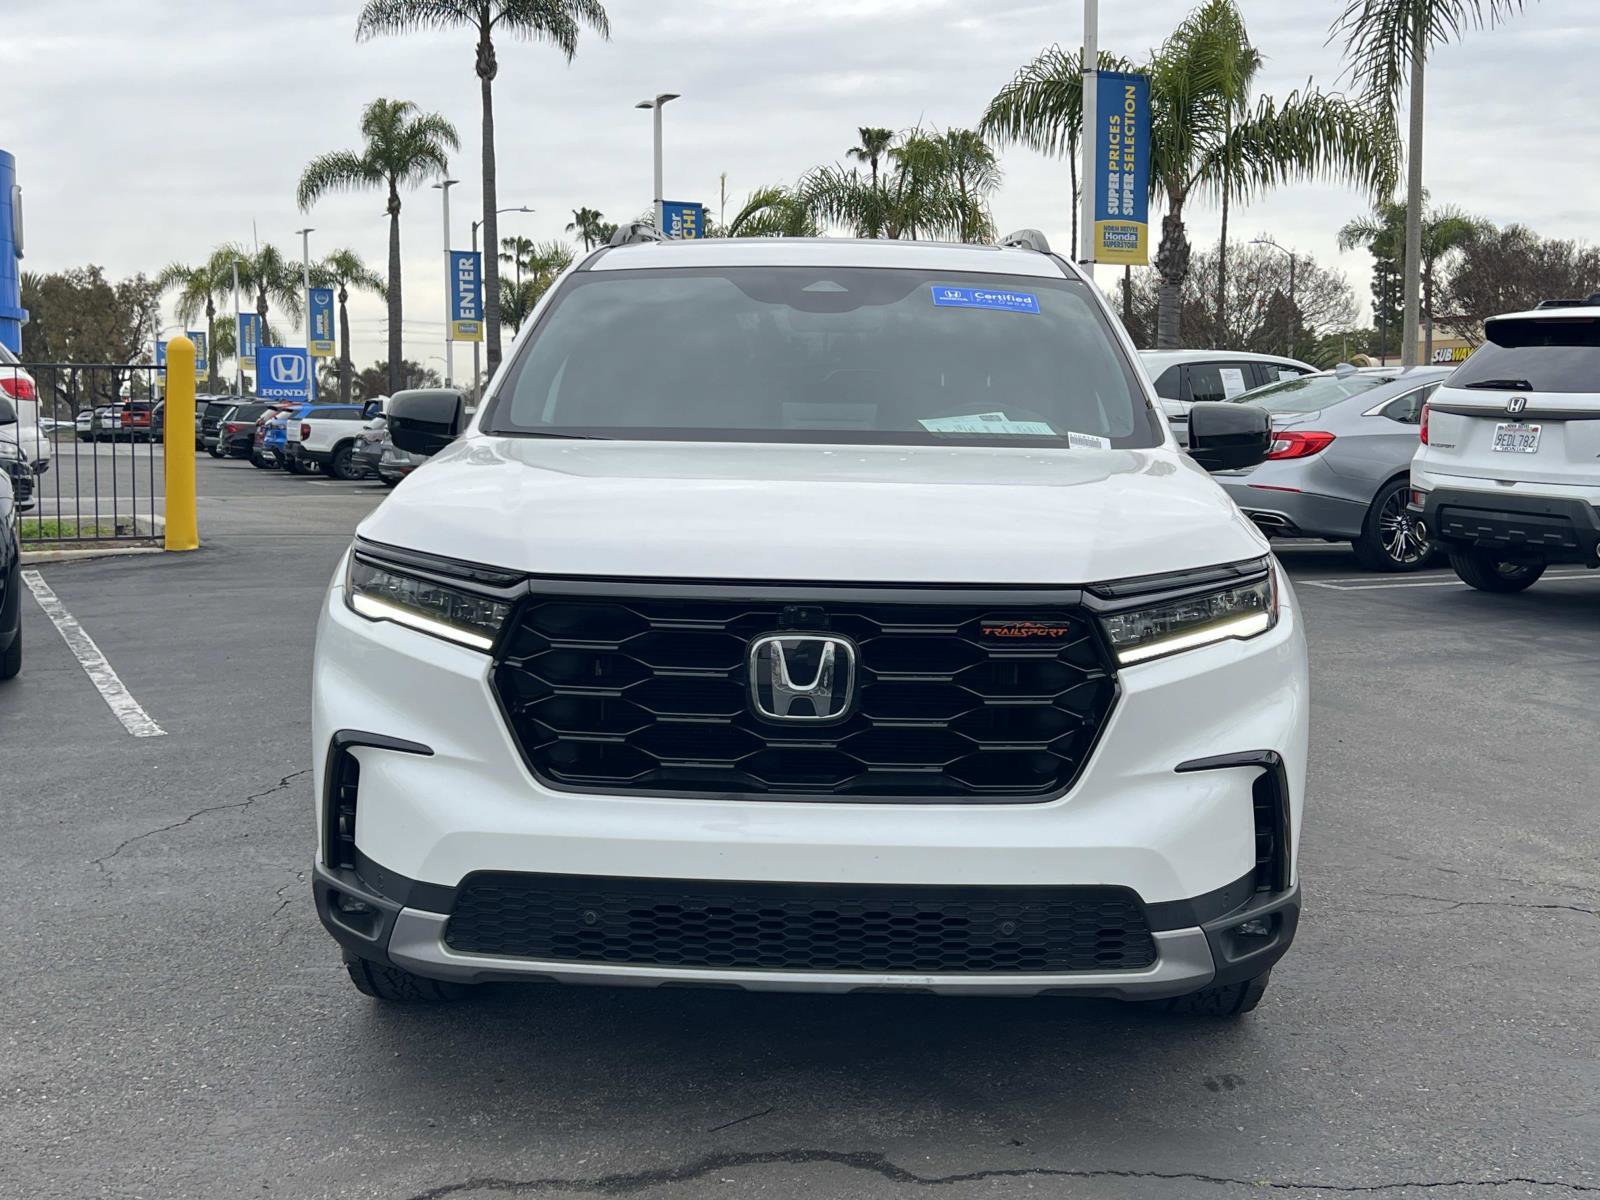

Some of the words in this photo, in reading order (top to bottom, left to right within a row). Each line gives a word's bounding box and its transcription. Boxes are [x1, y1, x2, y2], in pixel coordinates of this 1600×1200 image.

[1109, 115, 1121, 171] PRICES
[1124, 85, 1136, 171] SELECTION
[1107, 172, 1120, 216] SUPER
[1122, 173, 1135, 216] SUPER
[1105, 232, 1137, 240] Honda
[458, 257, 476, 319] ENTER
[974, 292, 1032, 304] Certified
[1495, 433, 1536, 448] 9EDL782
[983, 627, 1068, 638] TRAILSPORT
